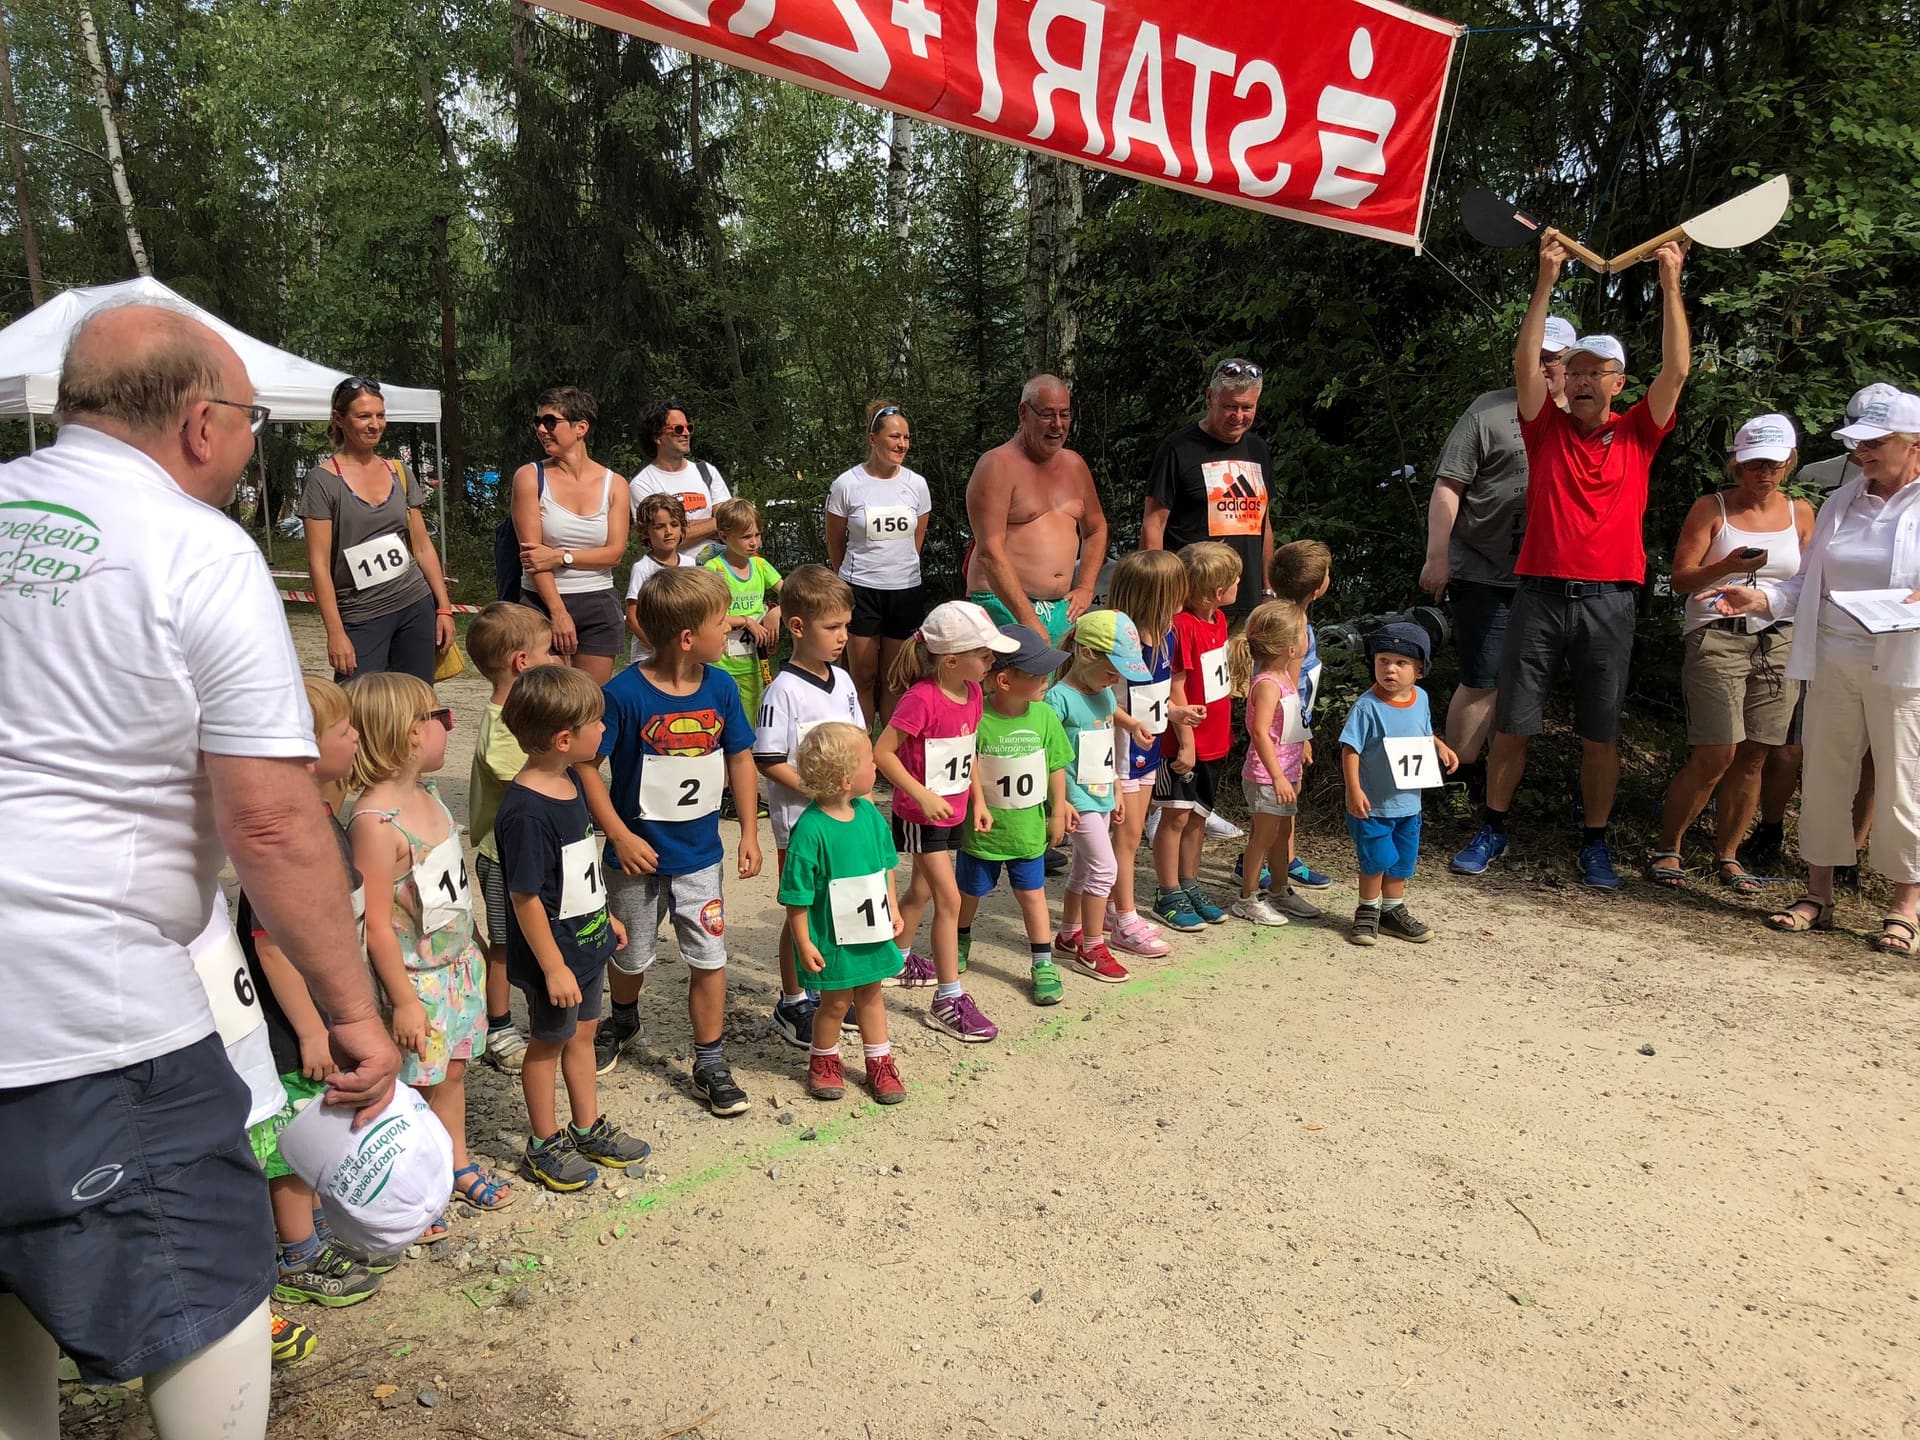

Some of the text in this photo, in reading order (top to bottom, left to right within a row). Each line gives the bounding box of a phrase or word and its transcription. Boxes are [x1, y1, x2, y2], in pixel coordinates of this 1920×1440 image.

[1216, 497, 1261, 511] adidas
[872, 516, 908, 532] 156
[358, 548, 403, 577] 118
[944, 754, 972, 781] 15
[1398, 755, 1422, 776] 17
[677, 779, 701, 806] 2
[996, 773, 1033, 797] 10
[438, 857, 468, 903] 14
[857, 893, 892, 927] 11
[234, 966, 255, 1007] 6
[336, 1119, 411, 1198] Waldmünchen
[336, 1154, 355, 1176] 1887
[348, 1142, 406, 1206] Turnverein
